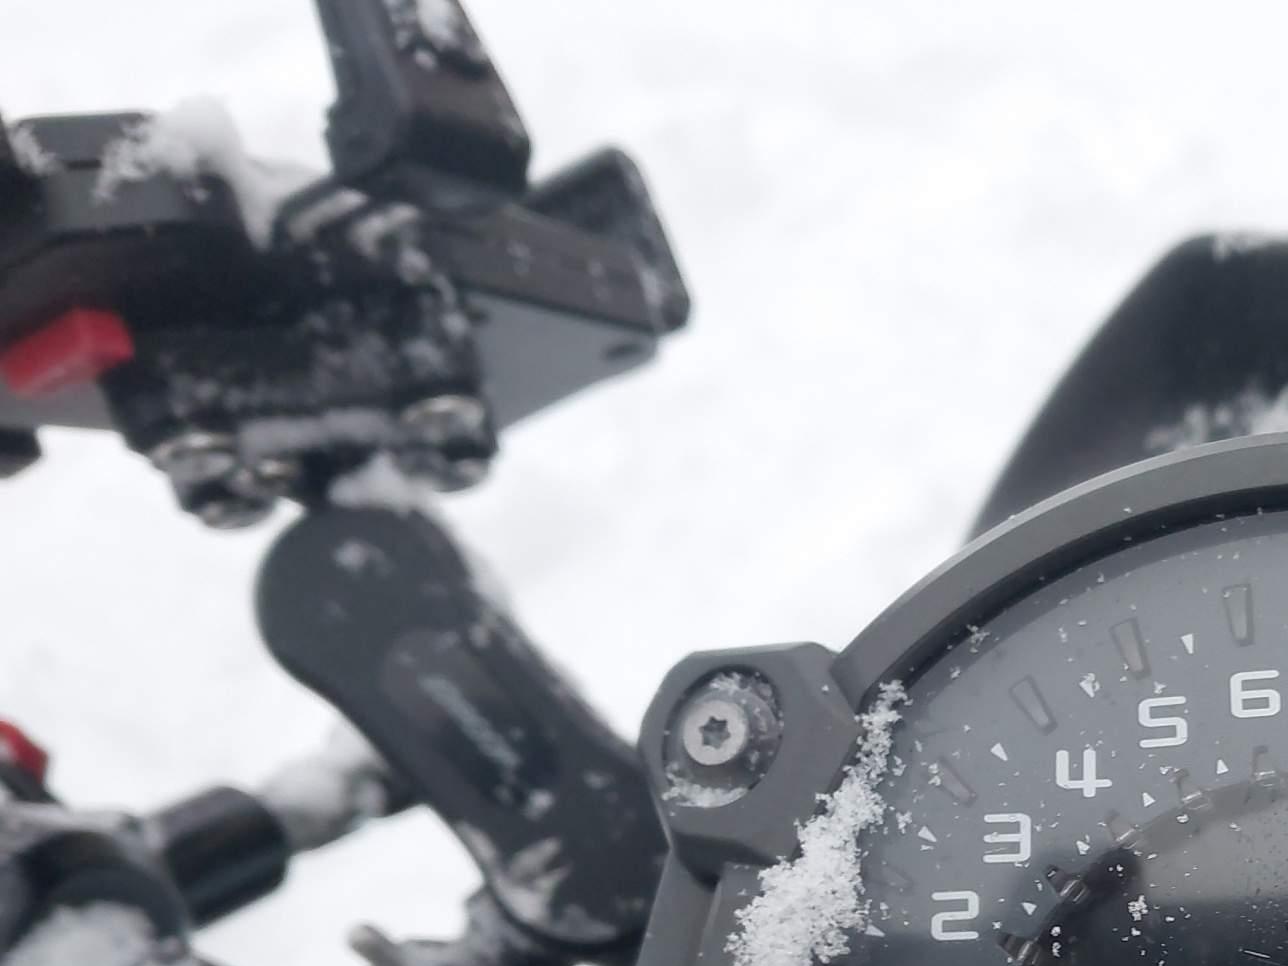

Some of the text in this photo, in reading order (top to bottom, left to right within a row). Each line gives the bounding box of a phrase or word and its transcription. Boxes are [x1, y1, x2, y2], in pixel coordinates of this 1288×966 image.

[1230, 669, 1281, 718] 6
[1138, 696, 1188, 748] 5
[1055, 749, 1112, 797] 4
[982, 813, 1032, 863] 3
[931, 890, 980, 940] 2
